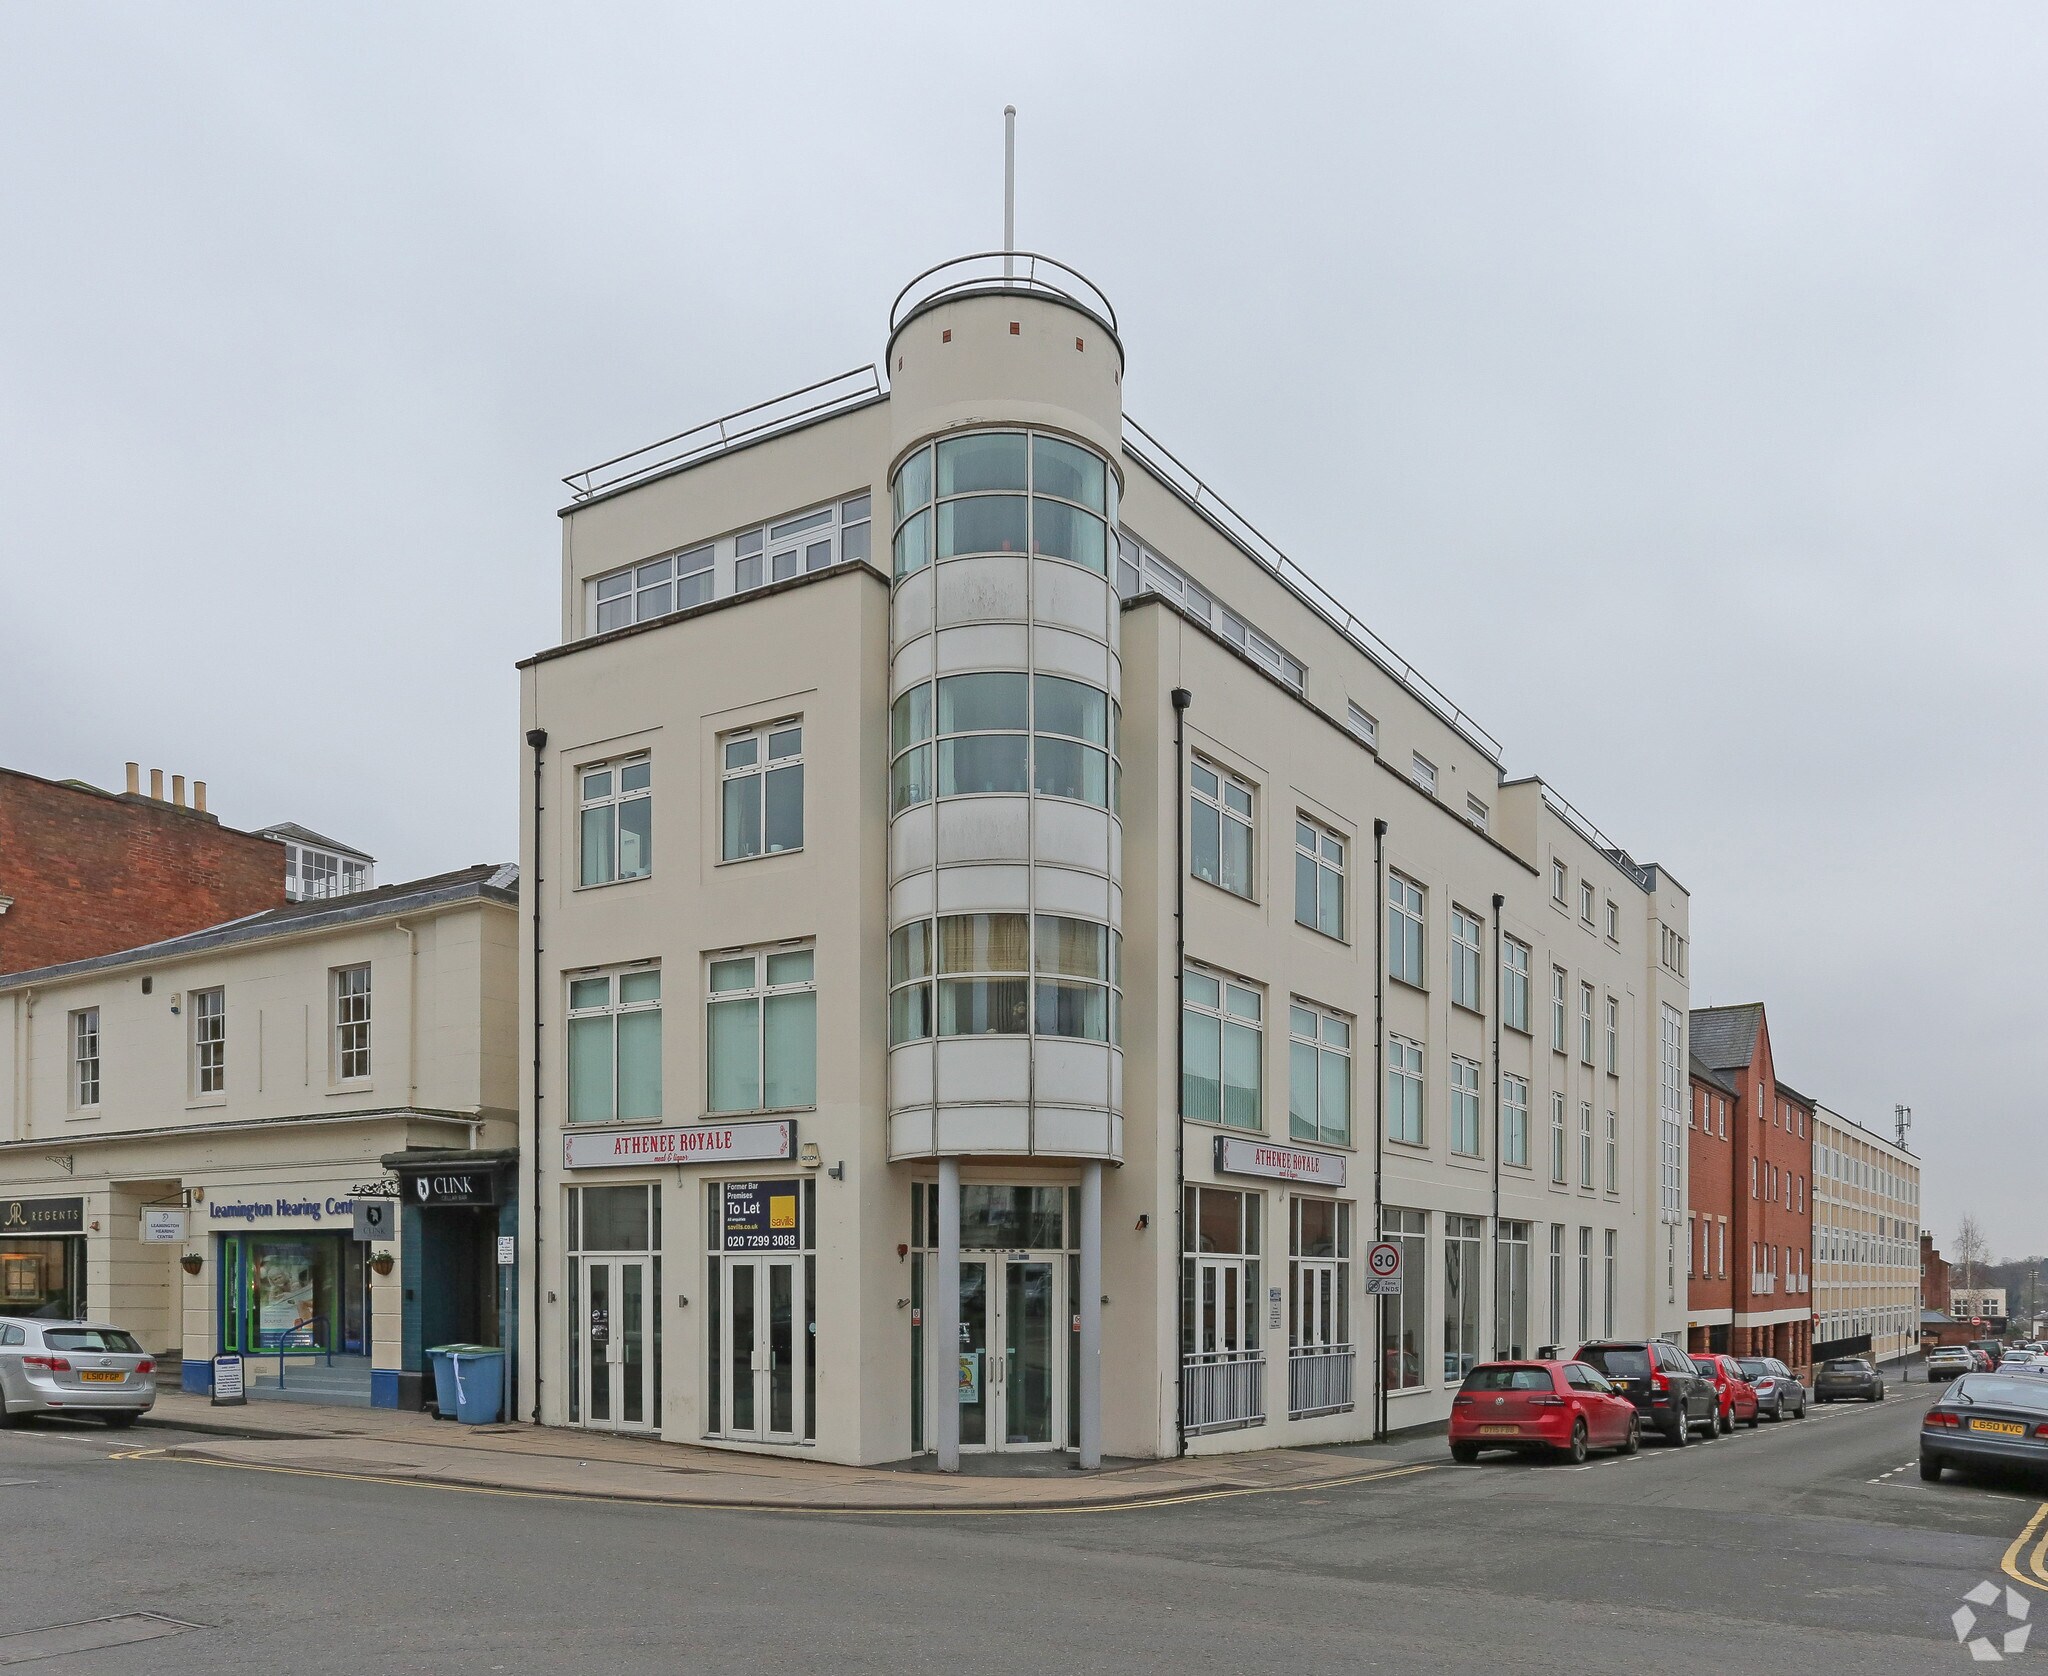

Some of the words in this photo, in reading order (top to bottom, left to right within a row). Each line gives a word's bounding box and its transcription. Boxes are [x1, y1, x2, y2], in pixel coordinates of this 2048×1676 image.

[613, 1134, 676, 1155] ATHENEE
[679, 1130, 733, 1152] ROYALE
[1255, 1148, 1292, 1169] ATHENEE
[1293, 1154, 1320, 1173] ROYALE
[433, 1176, 473, 1194] CLINK
[748, 1182, 759, 1190] Bar
[209, 1200, 273, 1222] Leamington
[276, 1197, 321, 1221] Hearing
[325, 1197, 354, 1215] Cent
[727, 1202, 740, 1214] To
[743, 1201, 761, 1214] Let
[32, 1209, 79, 1221] REGENTS
[771, 1215, 795, 1227] savills
[363, 1227, 386, 1235] CLINK
[727, 1236, 745, 1247] 020
[746, 1235, 770, 1247] 7299
[772, 1235, 796, 1246] 3088
[1374, 1254, 1395, 1267] 30
[1972, 1420, 2000, 1431] L650
